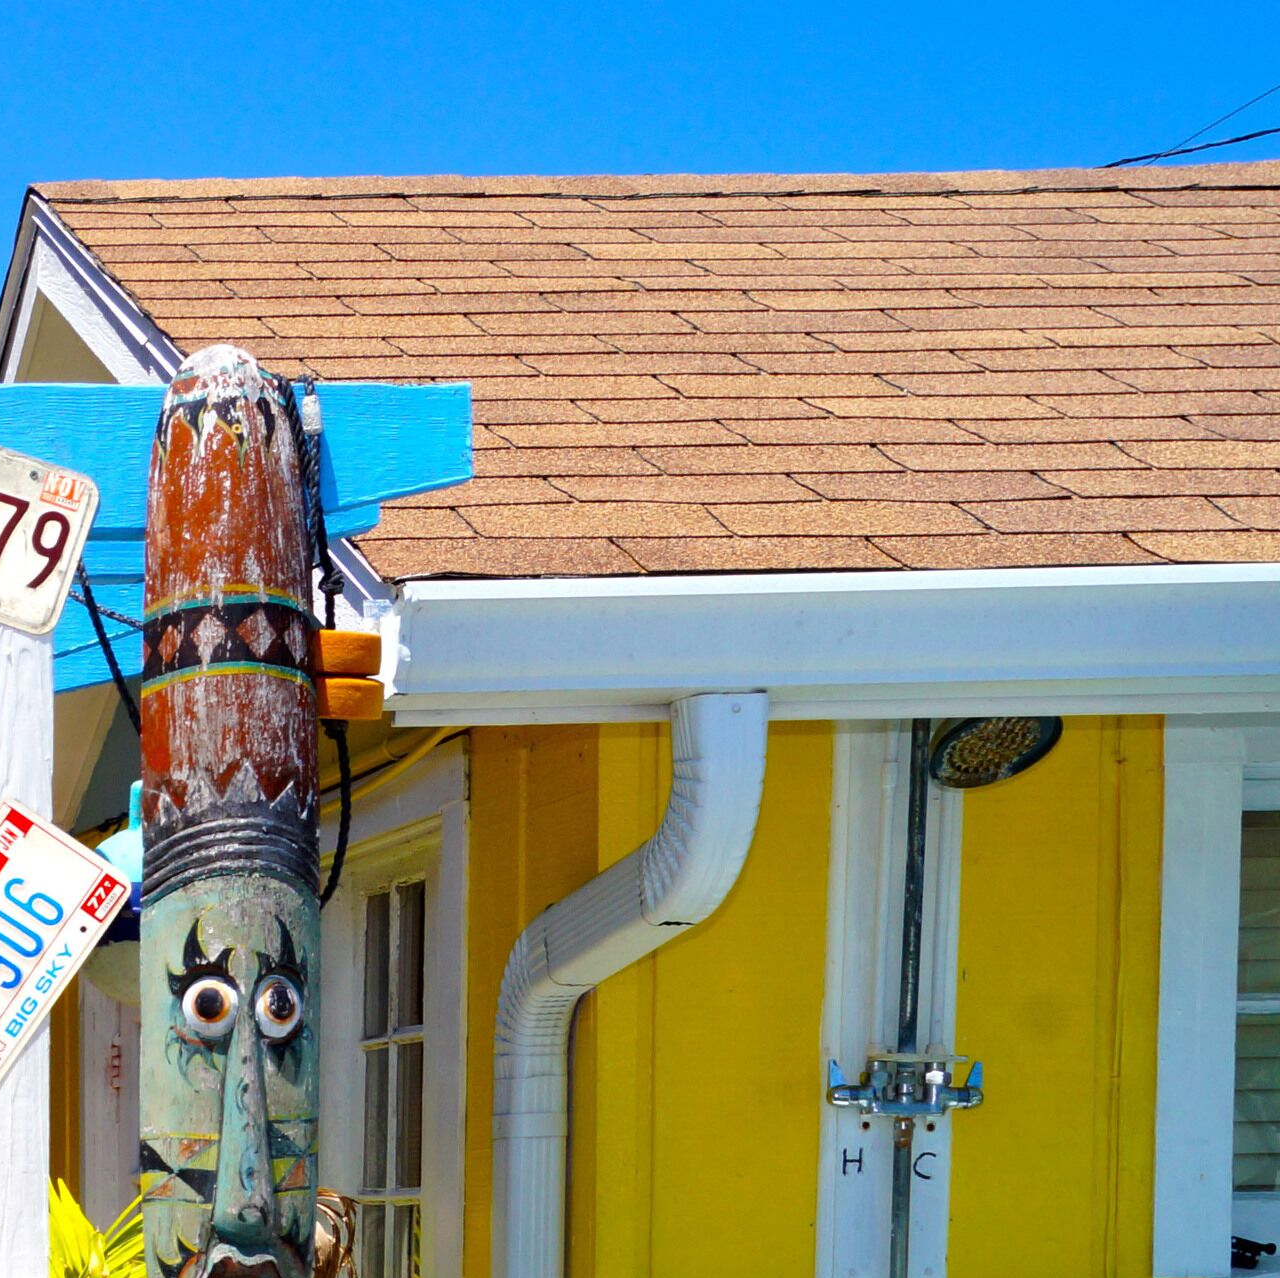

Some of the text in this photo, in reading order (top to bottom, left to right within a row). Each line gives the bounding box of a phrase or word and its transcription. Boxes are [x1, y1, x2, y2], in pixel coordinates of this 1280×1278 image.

[44, 471, 85, 502] NOV
[4, 943, 73, 1038] BIG SKY
[842, 1147, 863, 1176] H
[913, 1152, 936, 1179] C
